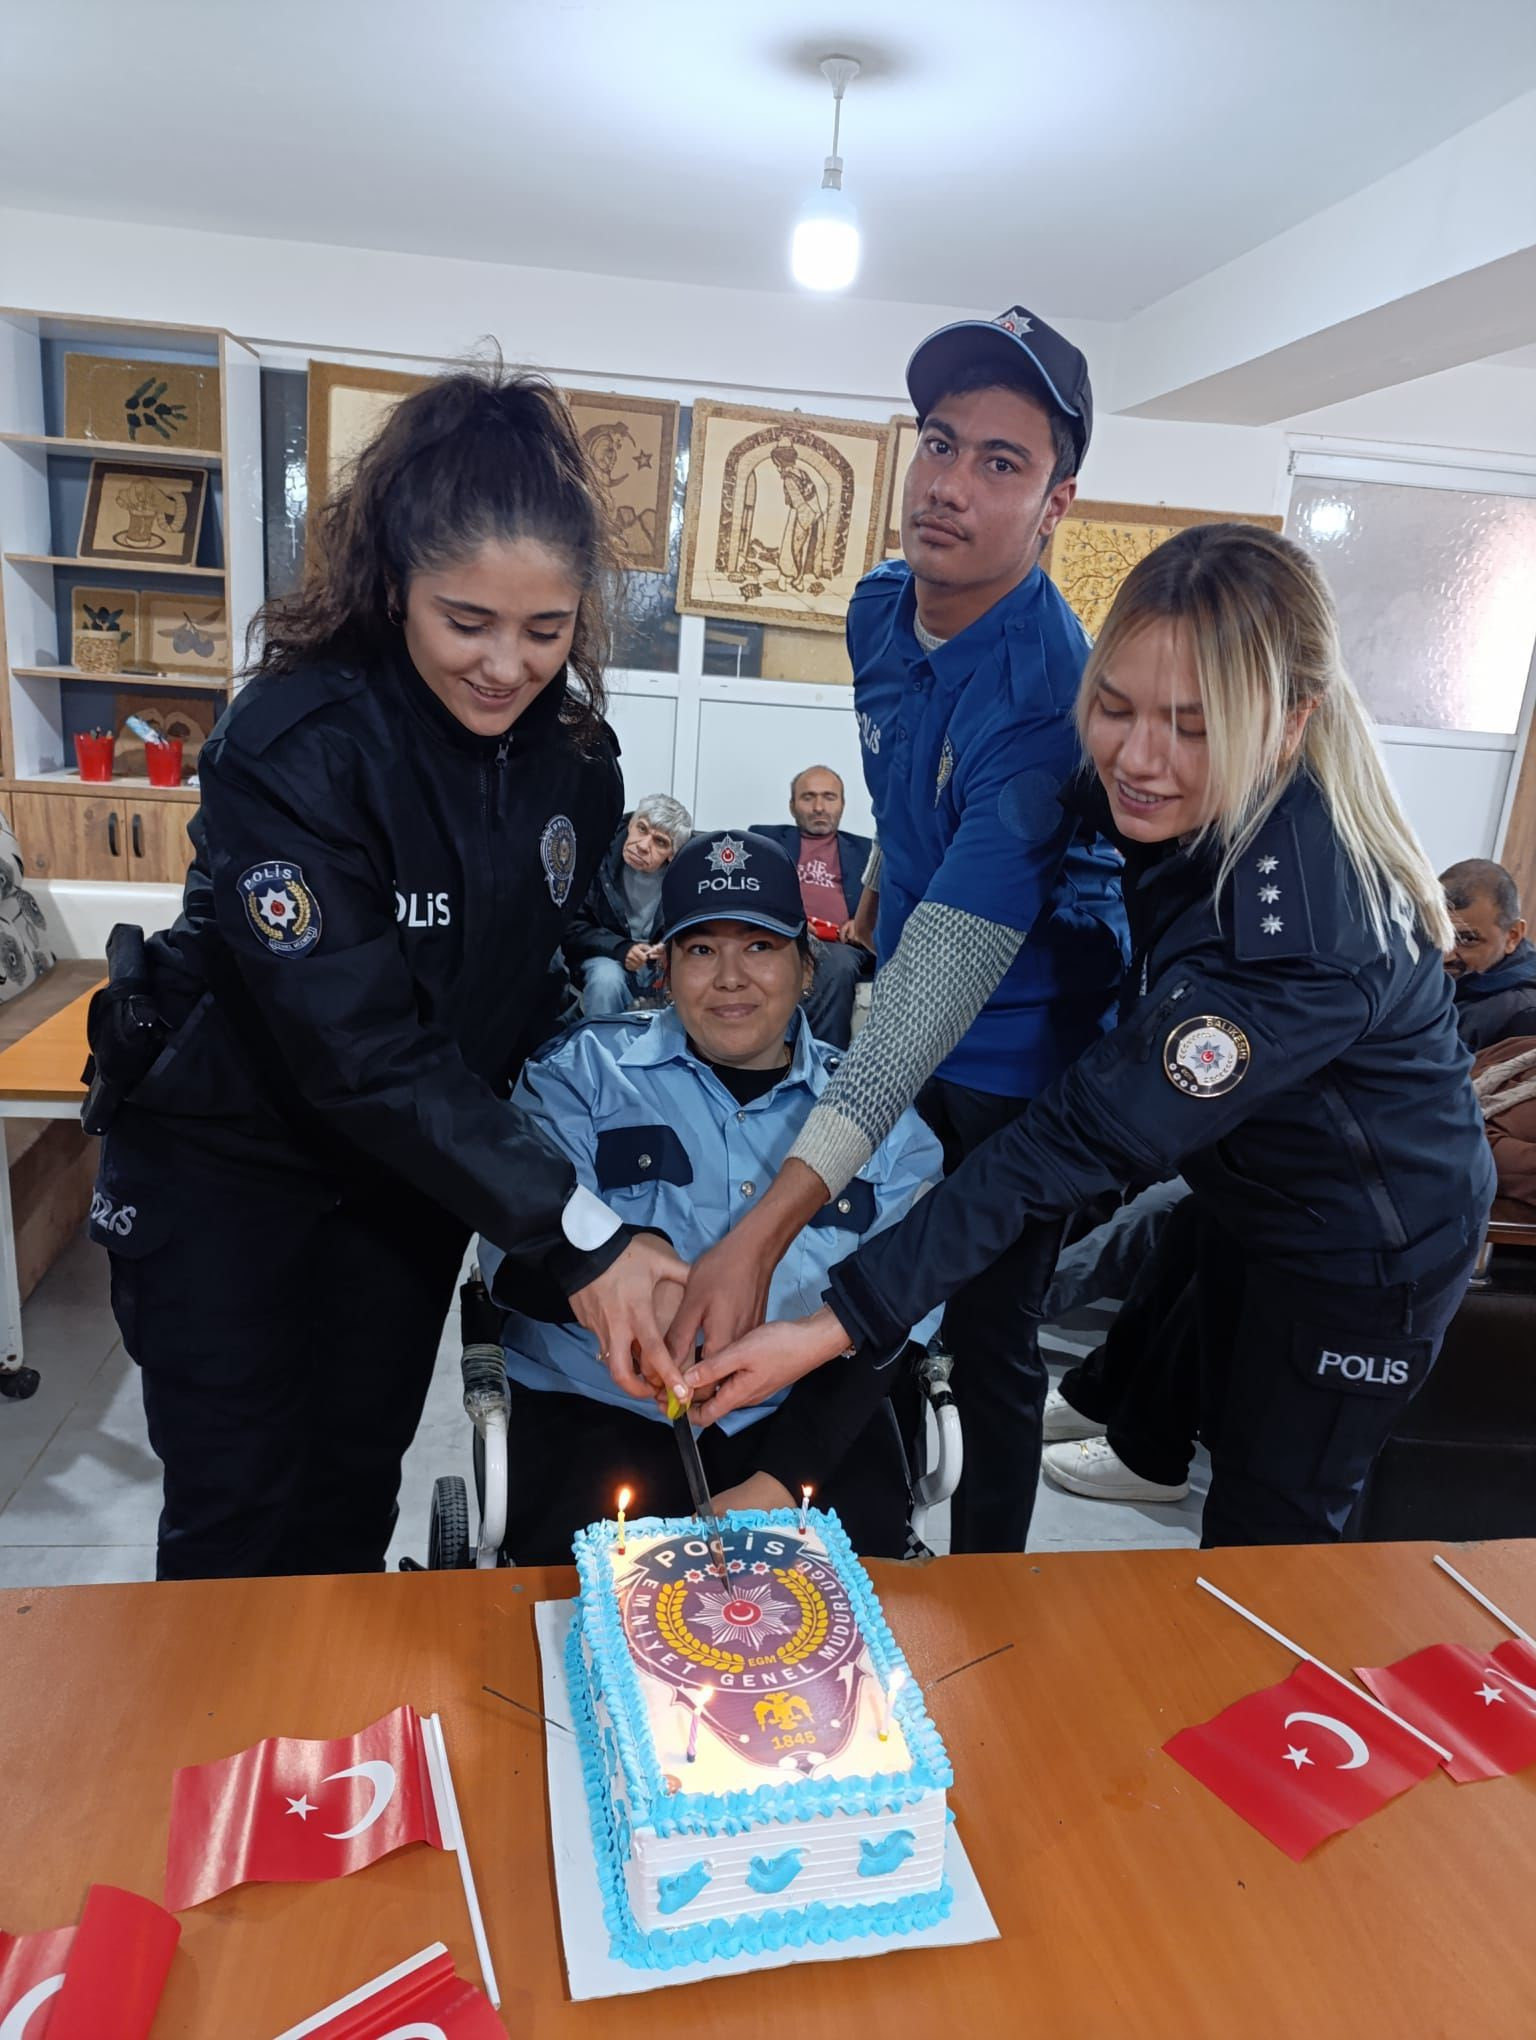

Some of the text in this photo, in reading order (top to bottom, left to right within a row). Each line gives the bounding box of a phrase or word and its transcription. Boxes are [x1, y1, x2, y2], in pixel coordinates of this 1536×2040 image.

[631, 1578, 697, 1676] EMNİYET
[720, 1663, 815, 1688] GENEL
[748, 1655, 777, 1668] EGM
[771, 1730, 817, 1750] 1845
